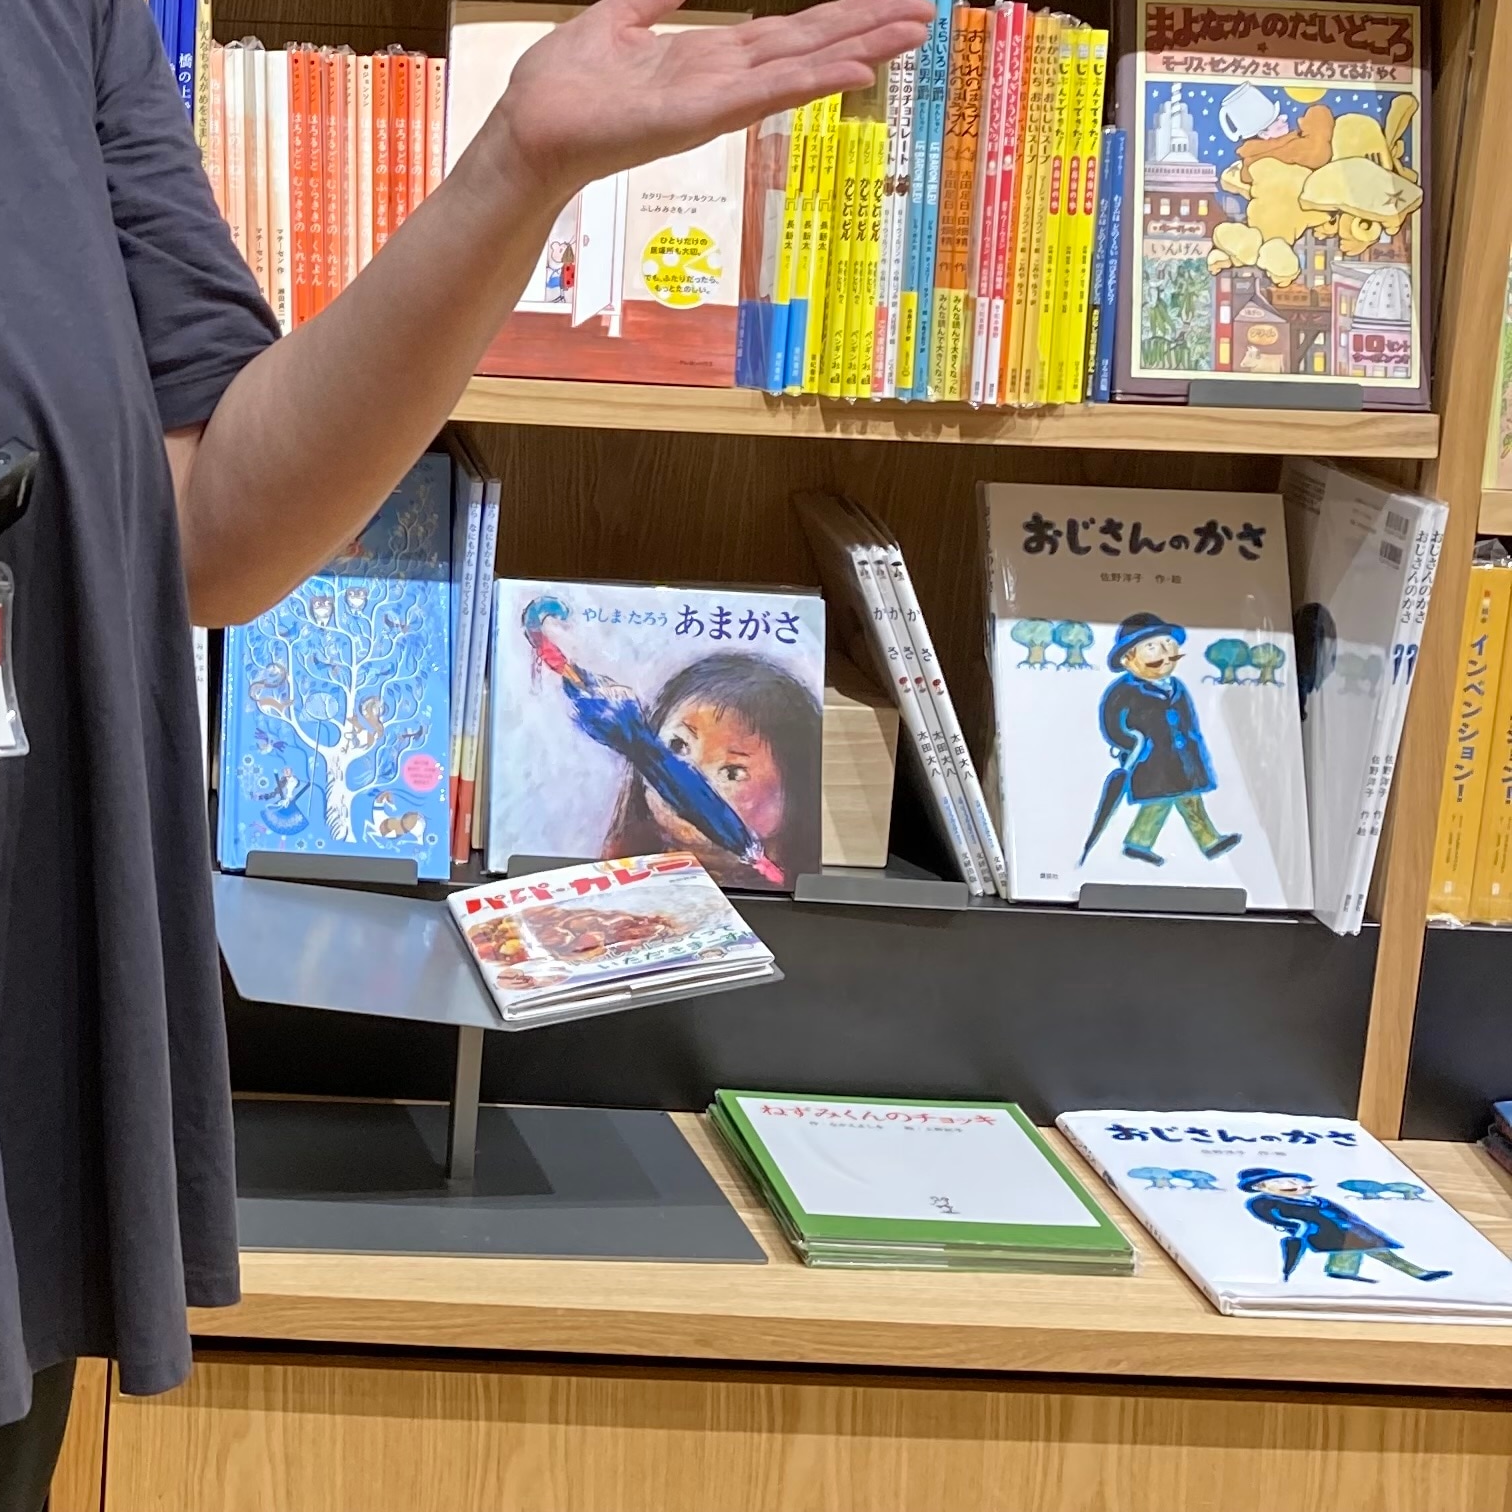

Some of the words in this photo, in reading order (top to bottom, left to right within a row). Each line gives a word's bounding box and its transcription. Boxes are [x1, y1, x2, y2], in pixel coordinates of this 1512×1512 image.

[931, 17, 949, 101] そらいろ男爵
[1031, 33, 1047, 88] せかいいち
[1044, 33, 1058, 88] せかいいち
[1145, 6, 1415, 64] まよなかのだいどころ
[899, 49, 917, 166] こねこのチョコレート
[960, 29, 985, 138] おしいれのぼうけん
[291, 112, 302, 170] はろるどと
[309, 113, 319, 171] はろるどと
[375, 117, 388, 175] はろるどの
[395, 117, 407, 175] はろるどの
[808, 101, 823, 175] ぼくはイスです
[823, 102, 838, 175] ぼくはイスです
[1025, 92, 1042, 165] おいしいスープ
[1039, 92, 1055, 165] おいしいスープ
[839, 176, 856, 242] かしこいビル
[855, 176, 871, 242] かしこいビル
[295, 238, 307, 285] くれよん
[310, 238, 323, 286] くれよん
[659, 235, 708, 247] ひとりだけの
[948, 295, 963, 395] みんな読んで大きくなった
[1022, 511, 1267, 561] おじさんのかさ
[479, 571, 491, 617] おちてくる
[1099, 572, 1143, 584] 佐野洋子
[1400, 530, 1428, 624] おじさんのかさ
[1414, 529, 1441, 625] おじさんのかさ
[674, 604, 801, 644] あまがさ
[918, 730, 942, 778] 太田大八
[932, 730, 958, 778] 太田大八
[950, 733, 975, 780] 太田大八
[761, 1104, 997, 1126] ねずみくんのチョッキ
[1105, 1123, 1359, 1147] おじさんのかさ
